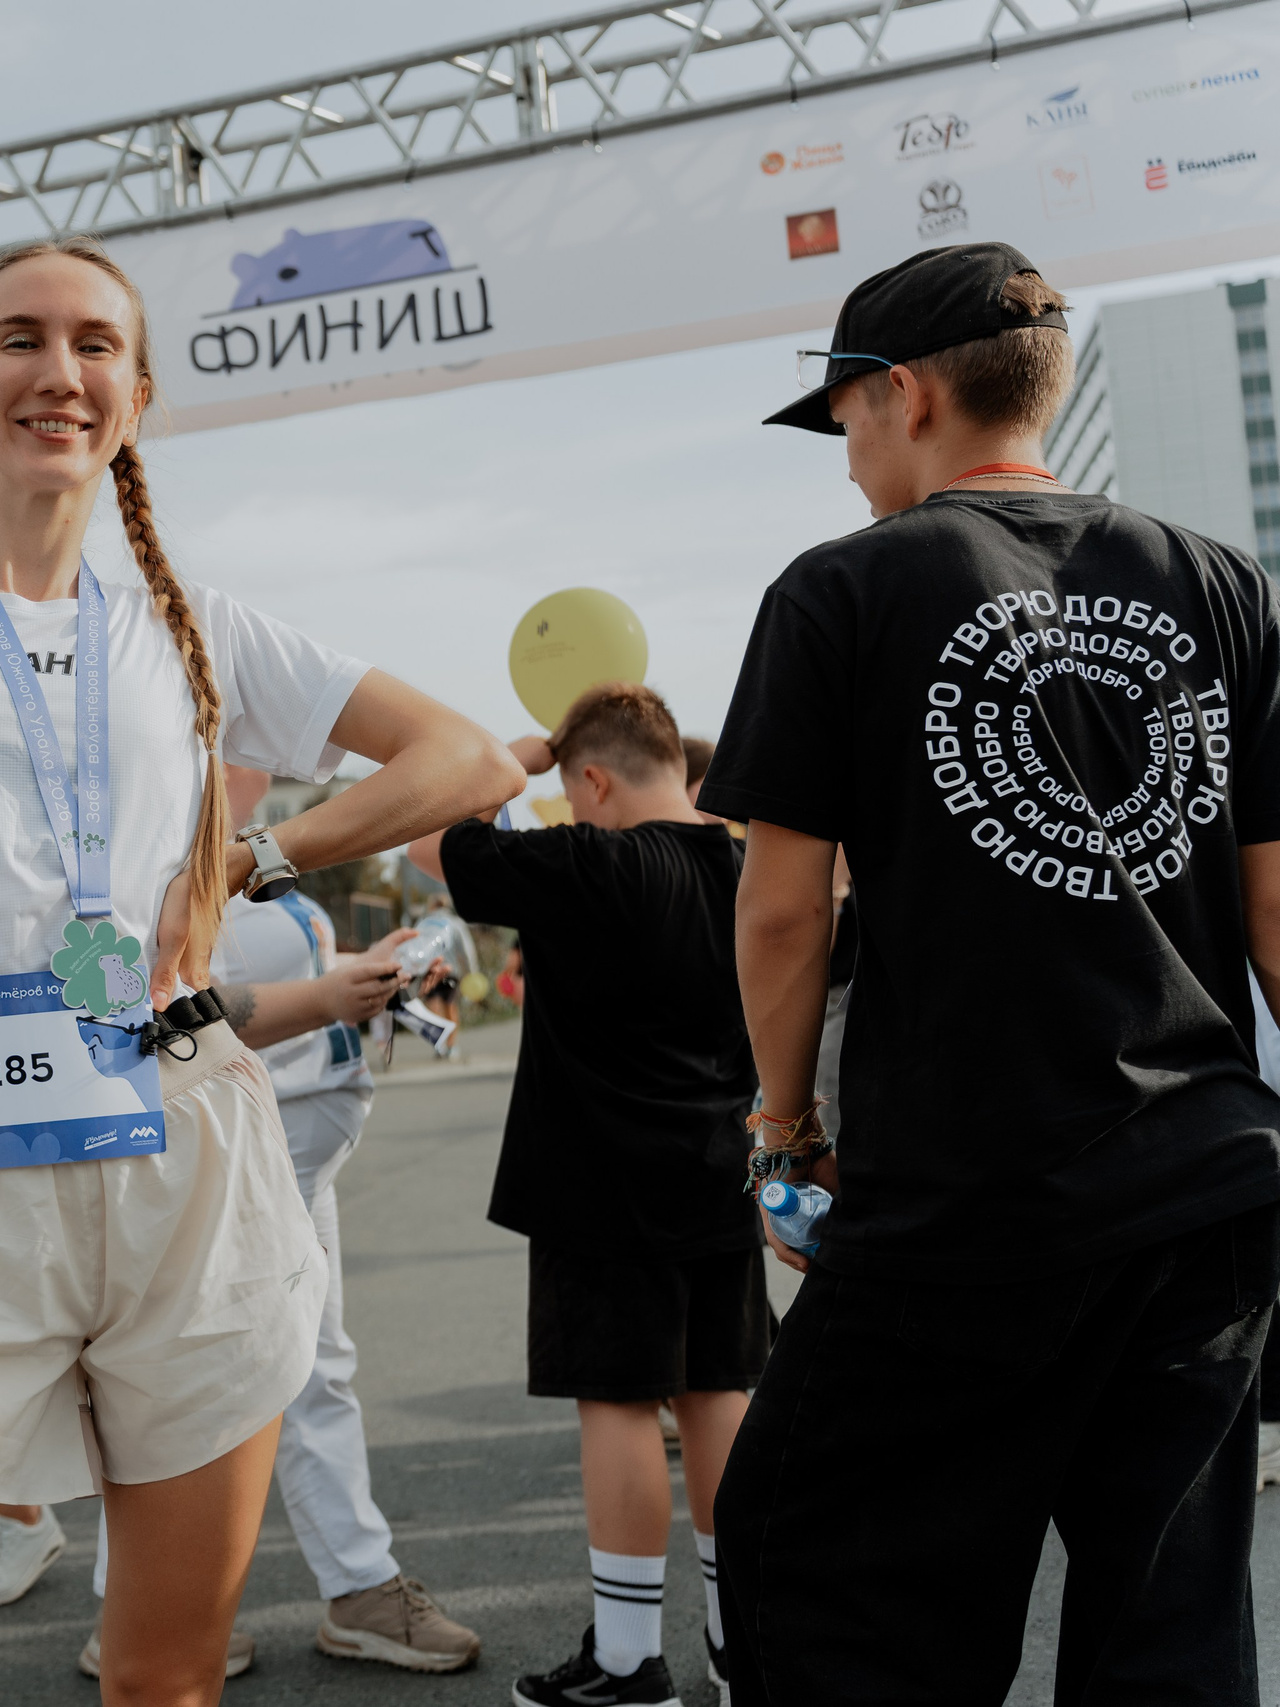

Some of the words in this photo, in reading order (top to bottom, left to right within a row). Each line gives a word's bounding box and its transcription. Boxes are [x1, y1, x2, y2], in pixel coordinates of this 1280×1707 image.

[1200, 67, 1261, 90] лента
[190, 277, 493, 375] ФИНИШ
[84, 620, 99, 666] Южного
[939, 590, 1057, 666] ТВОРЮ
[983, 627, 1067, 683] ТВОРЮ
[1063, 595, 1197, 663] ДОБРО
[1069, 631, 1167, 681] ДОБРО
[85, 670, 102, 764] волонтёров
[1075, 661, 1143, 700] ДОБРО
[5, 652, 36, 711] Южного
[30, 715, 55, 771] Урала
[47, 775, 73, 822] 2026
[925, 682, 990, 815] ДОБРО
[974, 701, 1026, 798] ДОБРО
[1011, 704, 1048, 776] ДОБРО
[1143, 707, 1167, 786] ТВОРЮ
[1167, 692, 1196, 800] ТВОРЮ
[1187, 678, 1230, 825] ТВОРЮ
[86, 770, 100, 824] Забег
[971, 818, 1119, 901] ТВОРЮ
